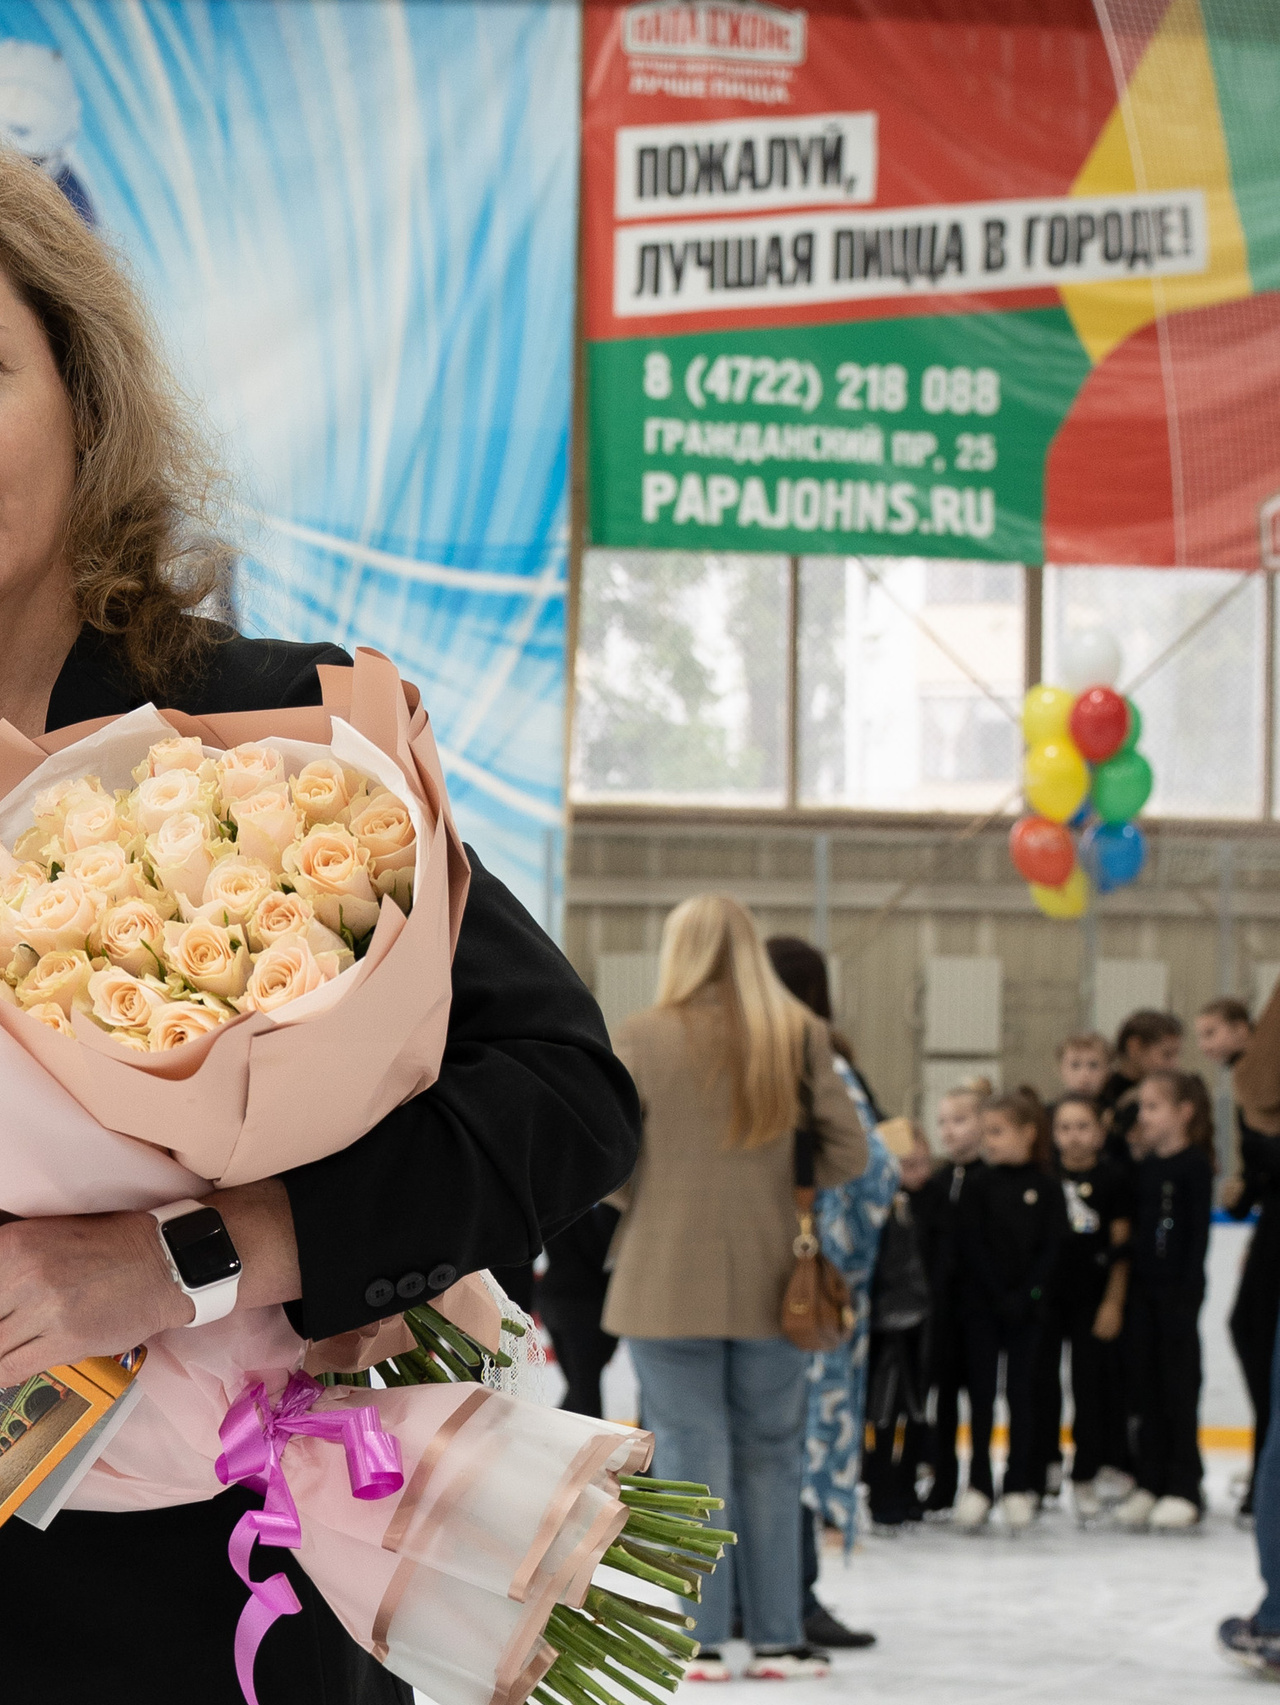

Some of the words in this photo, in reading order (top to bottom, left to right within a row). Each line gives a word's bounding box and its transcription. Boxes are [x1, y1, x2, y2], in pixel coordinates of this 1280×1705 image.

[636, 121, 857, 199] ПОЖАЛУЙ,
[635, 231, 815, 298] ЛУЧШАЯ
[833, 220, 966, 286] ПИЦЦА
[982, 218, 1008, 274] В
[1024, 204, 1192, 274] ГОРОДЕ!
[643, 351, 673, 400] 8
[684, 354, 822, 413] (4722)
[835, 361, 909, 412] 218
[921, 366, 1001, 416] 088
[643, 415, 886, 466] ГРАЖДАНСКИЙ
[954, 431, 999, 472] 25
[642, 471, 996, 540] PAPAJOHNS.RU
